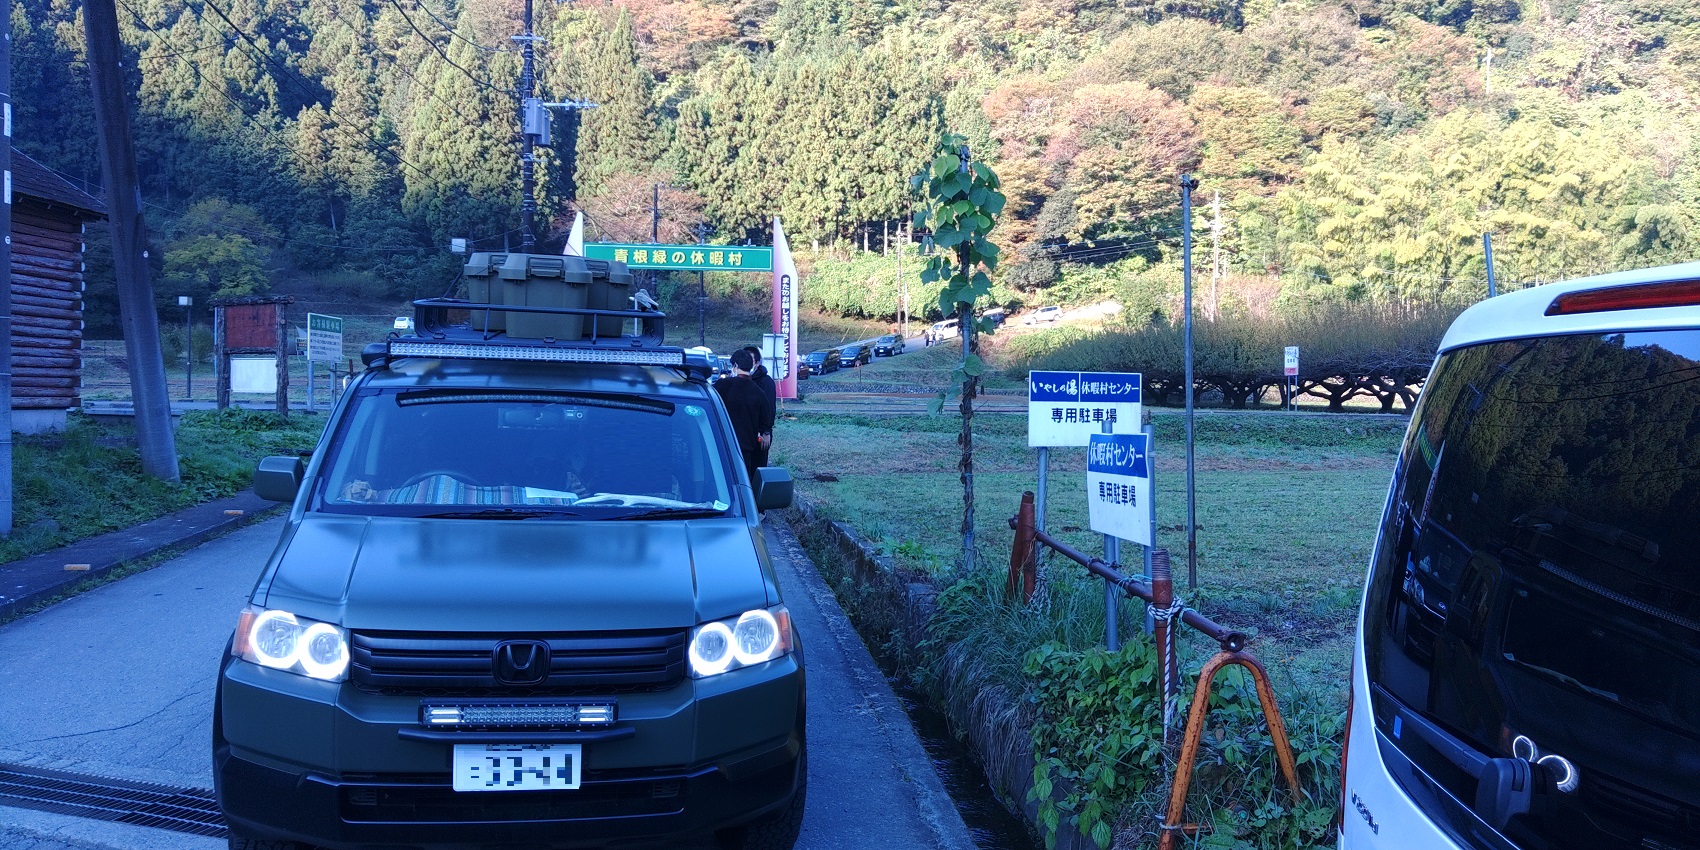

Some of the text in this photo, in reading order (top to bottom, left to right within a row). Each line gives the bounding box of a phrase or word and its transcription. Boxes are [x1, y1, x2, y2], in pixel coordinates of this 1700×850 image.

[614, 249, 743, 266] 青根緑の休暇村
[1031, 379, 1139, 396] いやしの湯 休暇村センター
[1051, 408, 1117, 423] 専用駐車場
[1090, 441, 1143, 468] 休暇村センター
[1098, 481, 1136, 507] 専用駐車場
